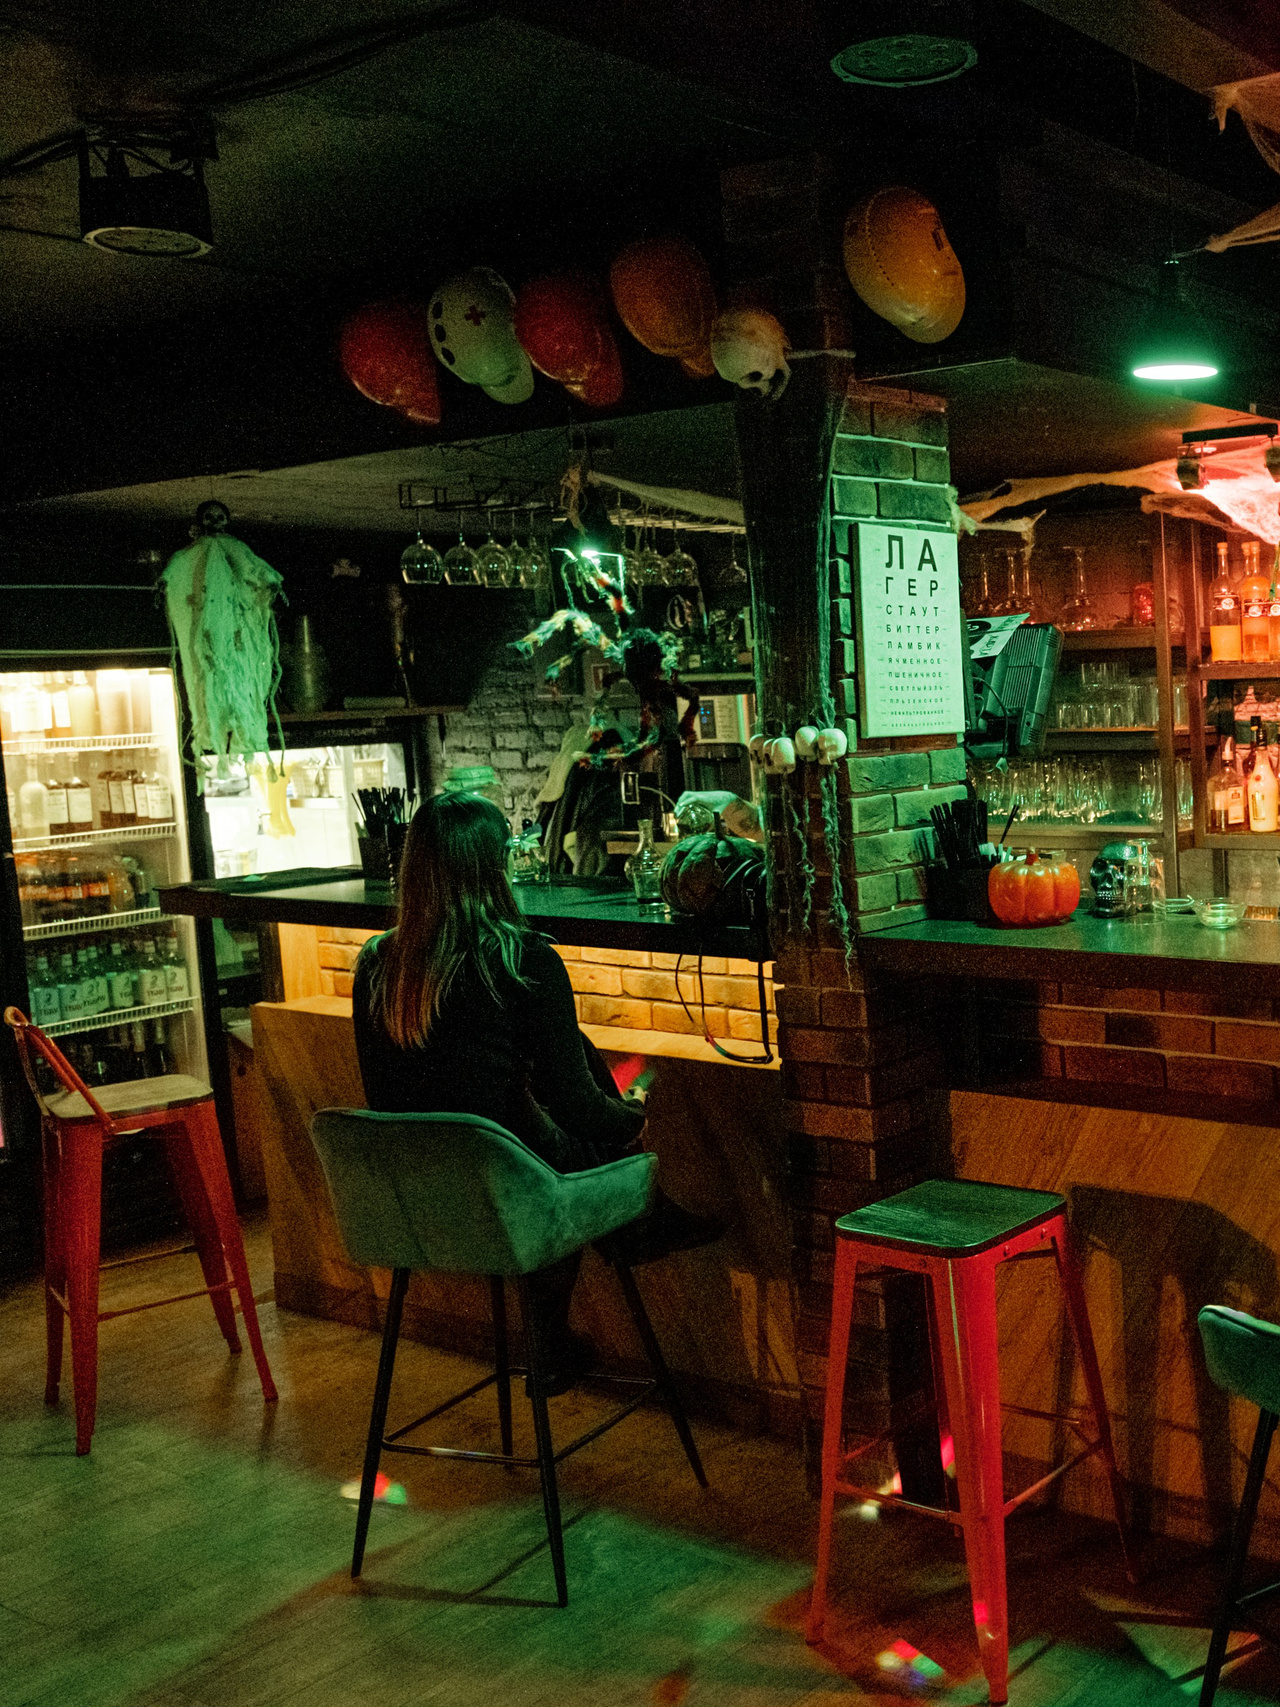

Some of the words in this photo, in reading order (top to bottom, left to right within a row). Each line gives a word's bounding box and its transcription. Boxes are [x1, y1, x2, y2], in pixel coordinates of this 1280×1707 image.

[885, 534, 938, 572] ЛА
[886, 576, 939, 598] ГЕР
[886, 604, 939, 617] СТАУТ
[886, 624, 940, 634] БИТТЕР
[887, 641, 941, 650] ЛАМБИК
[888, 657, 941, 665] ЯЧМЕННОЕ
